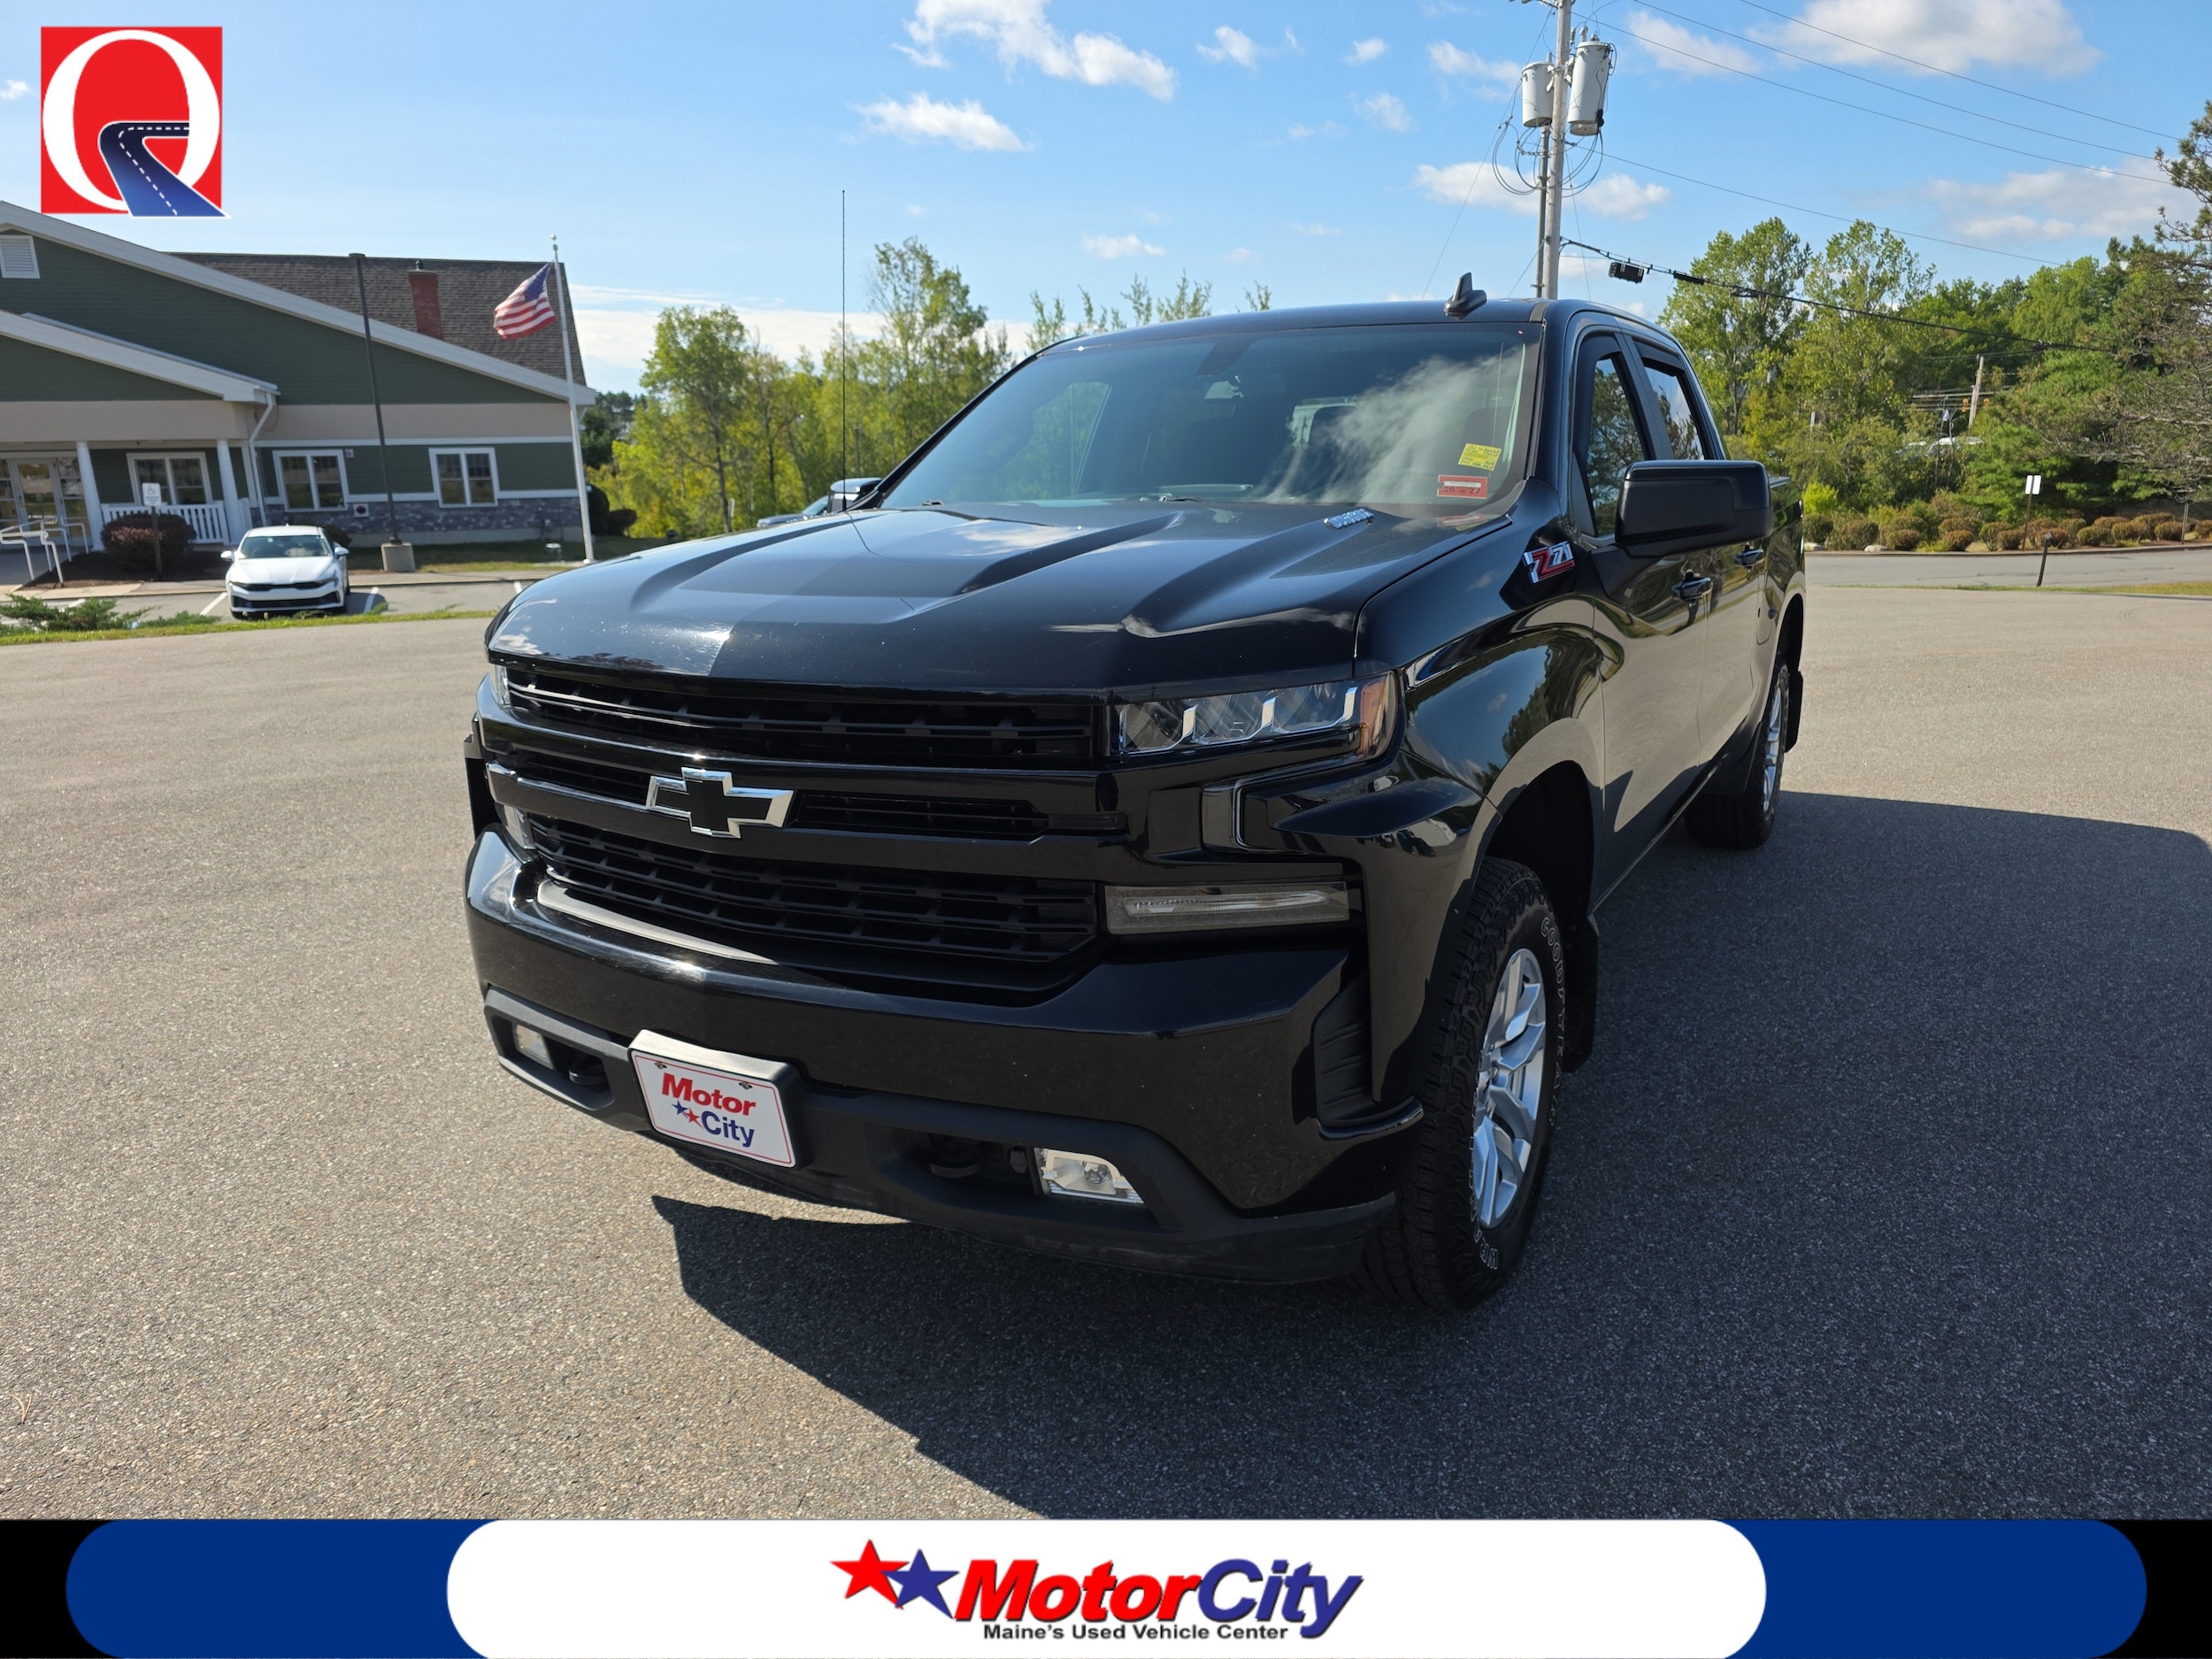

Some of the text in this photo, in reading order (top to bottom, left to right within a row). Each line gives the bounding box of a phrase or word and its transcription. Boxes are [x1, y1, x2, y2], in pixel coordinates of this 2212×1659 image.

[1524, 541, 1575, 584] Z71
[662, 1072, 757, 1116] Motor
[701, 1110, 755, 1148] City
